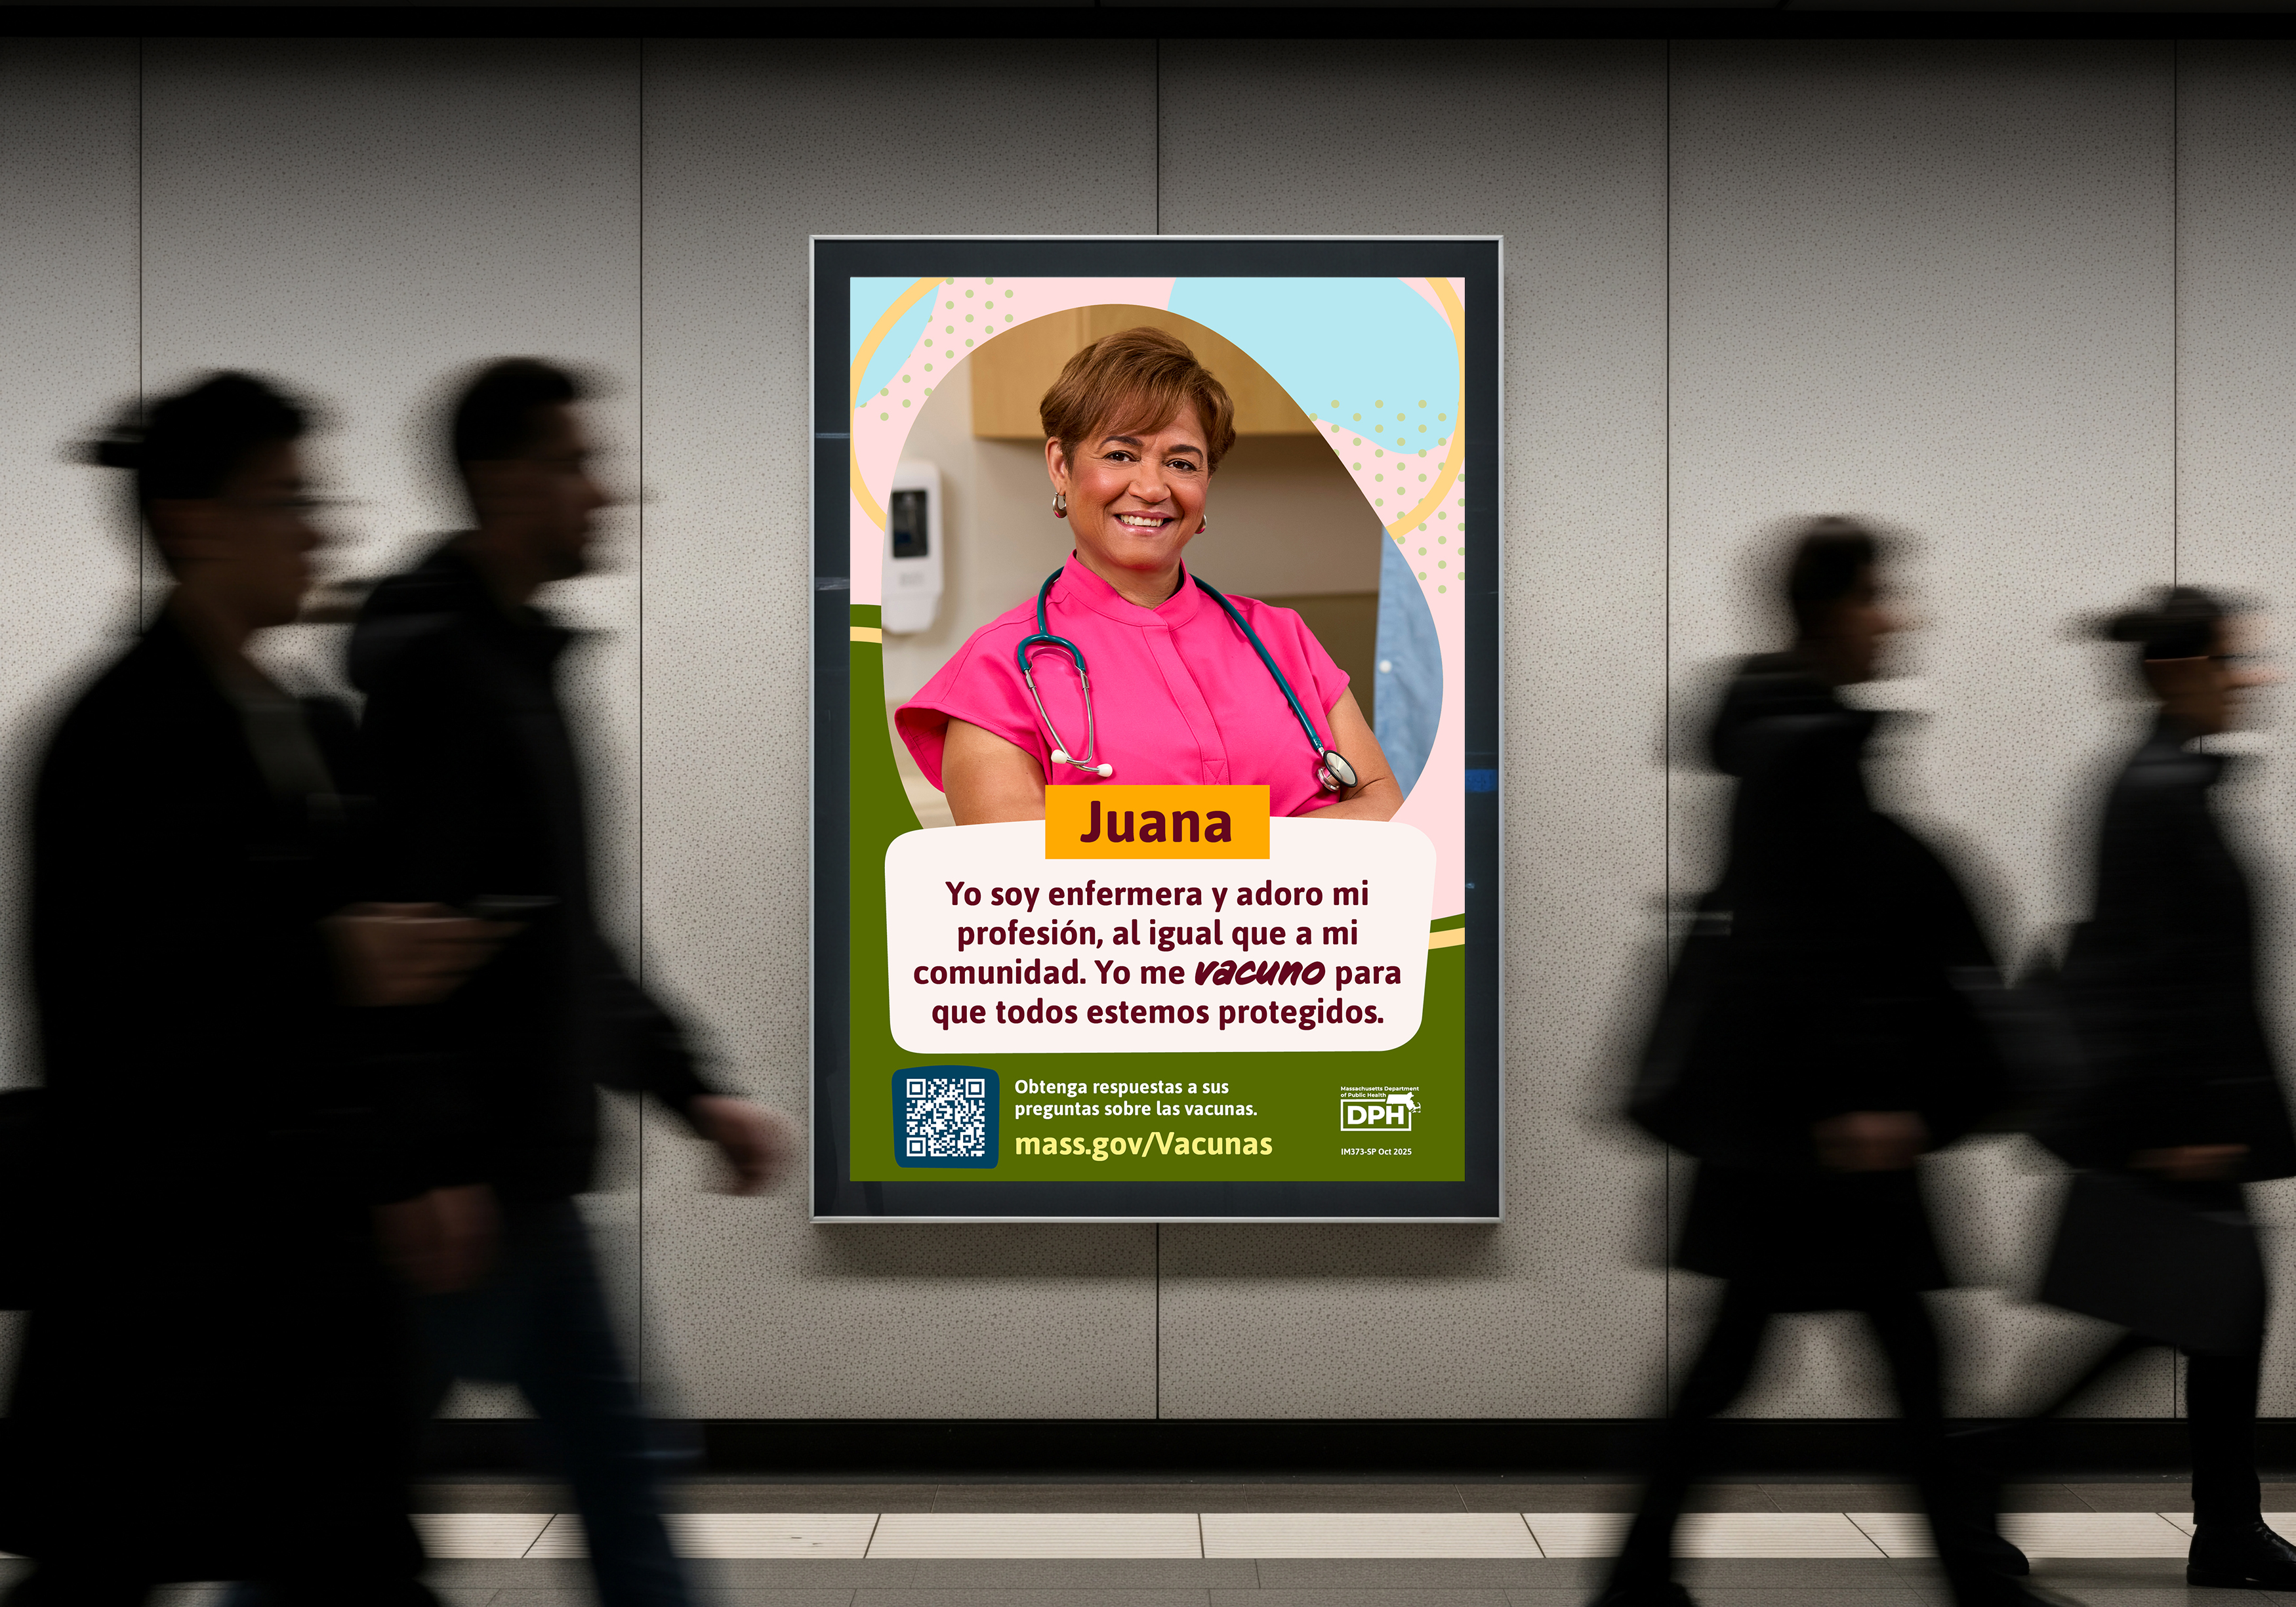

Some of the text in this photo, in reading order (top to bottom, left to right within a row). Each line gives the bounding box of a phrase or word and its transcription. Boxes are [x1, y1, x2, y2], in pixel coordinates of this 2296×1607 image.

[1080, 800, 1232, 843] Juana
[945, 879, 1368, 913] Yo soy enfermera y adoro mi
[958, 918, 1357, 952] profesión, al igual que a mi
[914, 958, 1401, 991] comunidad. Yo me vacuno para
[932, 997, 1384, 1030] que todos estemos protegidos.
[1015, 1078, 1229, 1098] Obtenga respuestas a sus
[1015, 1100, 1258, 1120] preguntas sobre las vacunas.
[1347, 1105, 1404, 1125] DPH
[1015, 1131, 1273, 1162] mass.gov/Vacunas
